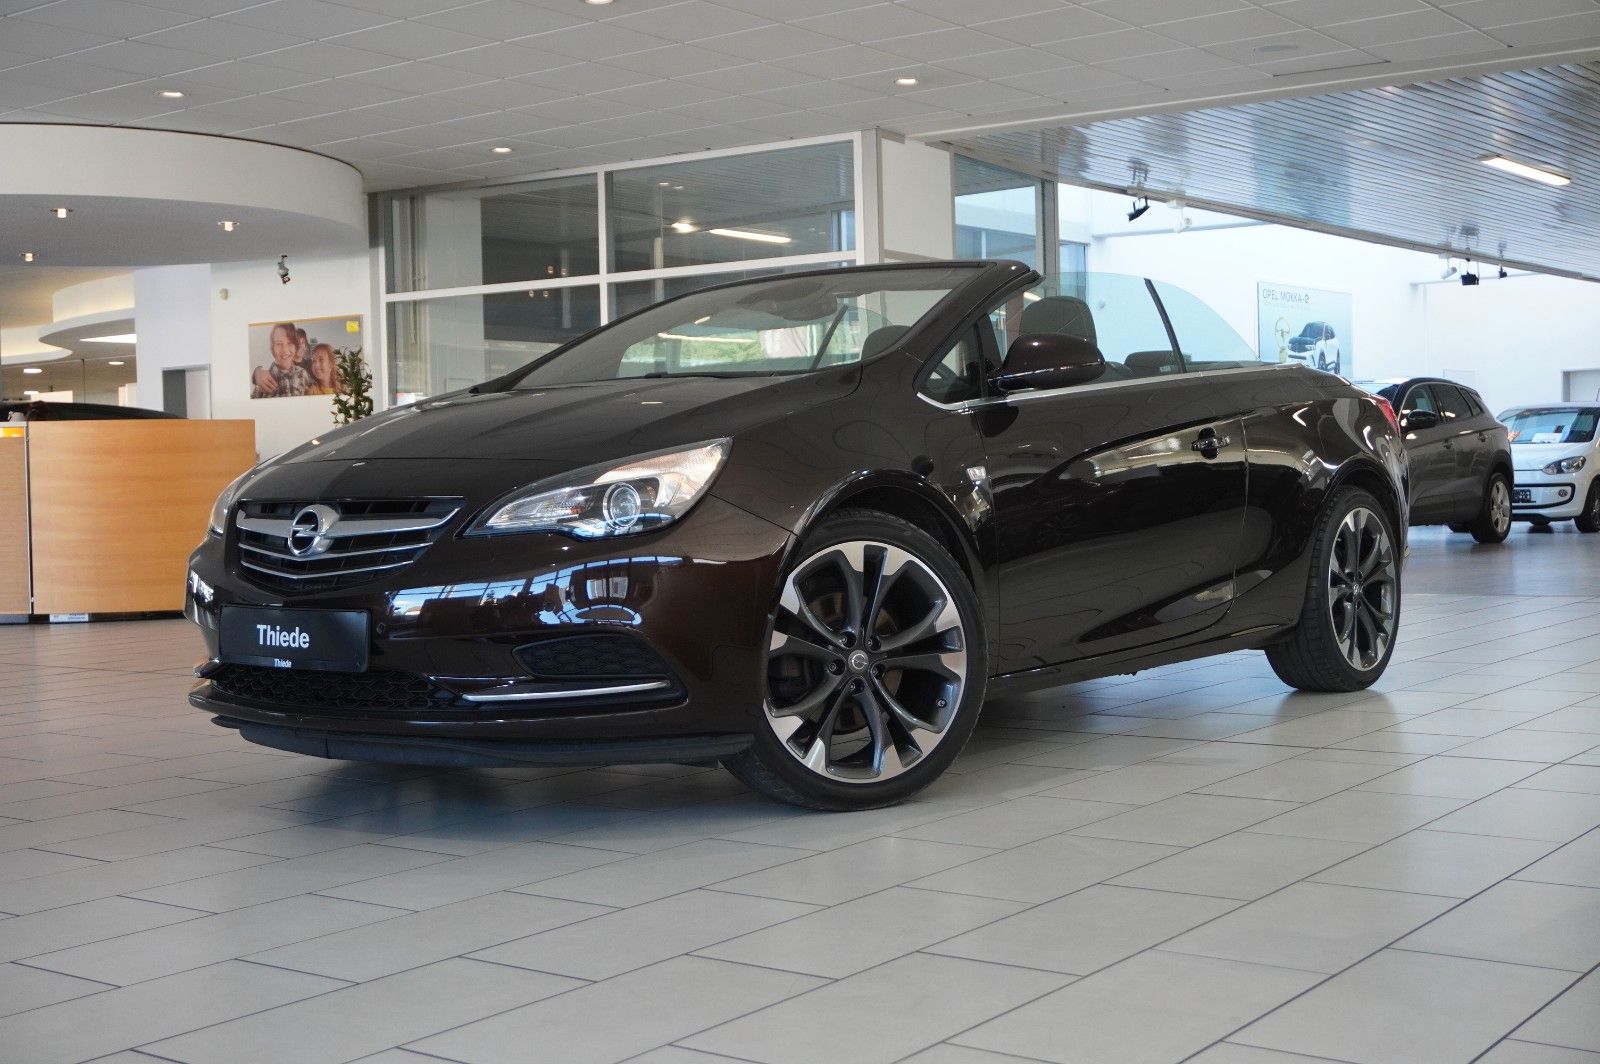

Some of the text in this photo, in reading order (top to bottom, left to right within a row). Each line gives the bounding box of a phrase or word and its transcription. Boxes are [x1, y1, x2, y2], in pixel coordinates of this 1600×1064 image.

[1262, 288, 1279, 301] OPEL
[256, 624, 310, 649] Thiede
[274, 658, 292, 668] Thiede
